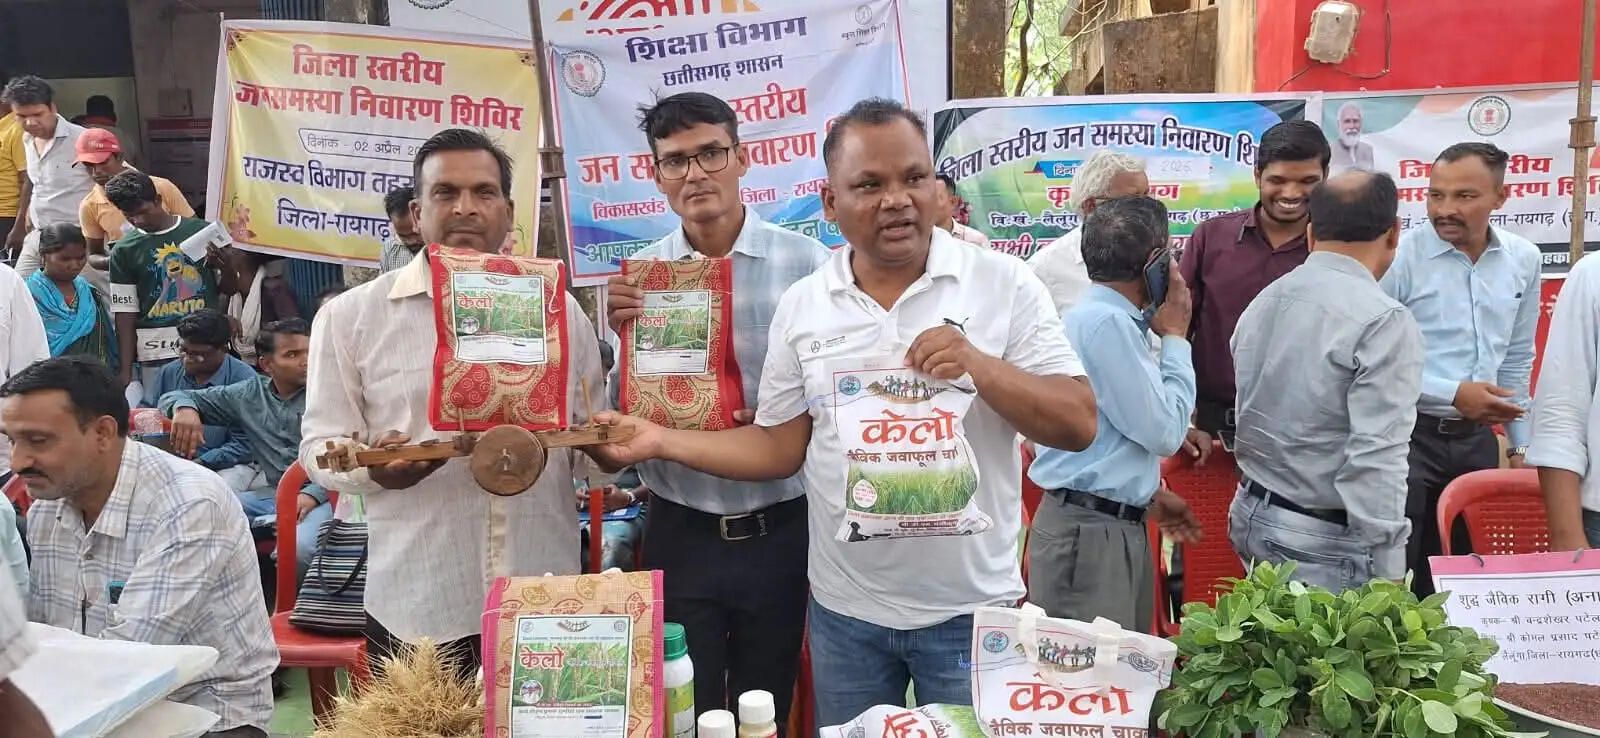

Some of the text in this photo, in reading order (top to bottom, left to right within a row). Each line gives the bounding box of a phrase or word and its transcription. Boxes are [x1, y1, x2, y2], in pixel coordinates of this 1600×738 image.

[625, 36, 708, 63] शिक्षा
[716, 16, 807, 49] विभाग
[292, 44, 445, 86] जिला स्तरीय
[662, 54, 784, 87] छत्तीसगढ़ शासन
[350, 86, 444, 123] निवारण
[450, 94, 523, 131] शिविर
[354, 140, 369, 153] 02
[989, 127, 1048, 166] स्तरीय
[1053, 124, 1086, 150] जन
[1091, 123, 1155, 146] समस्या
[1161, 116, 1232, 158] निवारण
[578, 155, 619, 184] जन
[739, 131, 816, 168] वारण
[242, 157, 305, 186] राजस्व
[308, 159, 367, 192] विभाग
[1398, 159, 1432, 179] जि
[1047, 186, 1072, 209] कृ
[276, 197, 390, 241] जिला-रायगढ़
[593, 198, 667, 220] विकासखंड
[1489, 212, 1554, 228] ला-रायगढ़
[112, 294, 134, 305] Best
[148, 298, 206, 319] NARUTO
[457, 291, 494, 309] केलो
[640, 312, 667, 327] केलो
[860, 408, 959, 445] केलो
[886, 450, 937, 468] जवाफूल
[1458, 588, 1600, 610] शुद्ध जैविक रागी (अना
[1584, 628, 1600, 640] पटे
[519, 646, 564, 668] केलो
[1006, 672, 1135, 716] केलो
